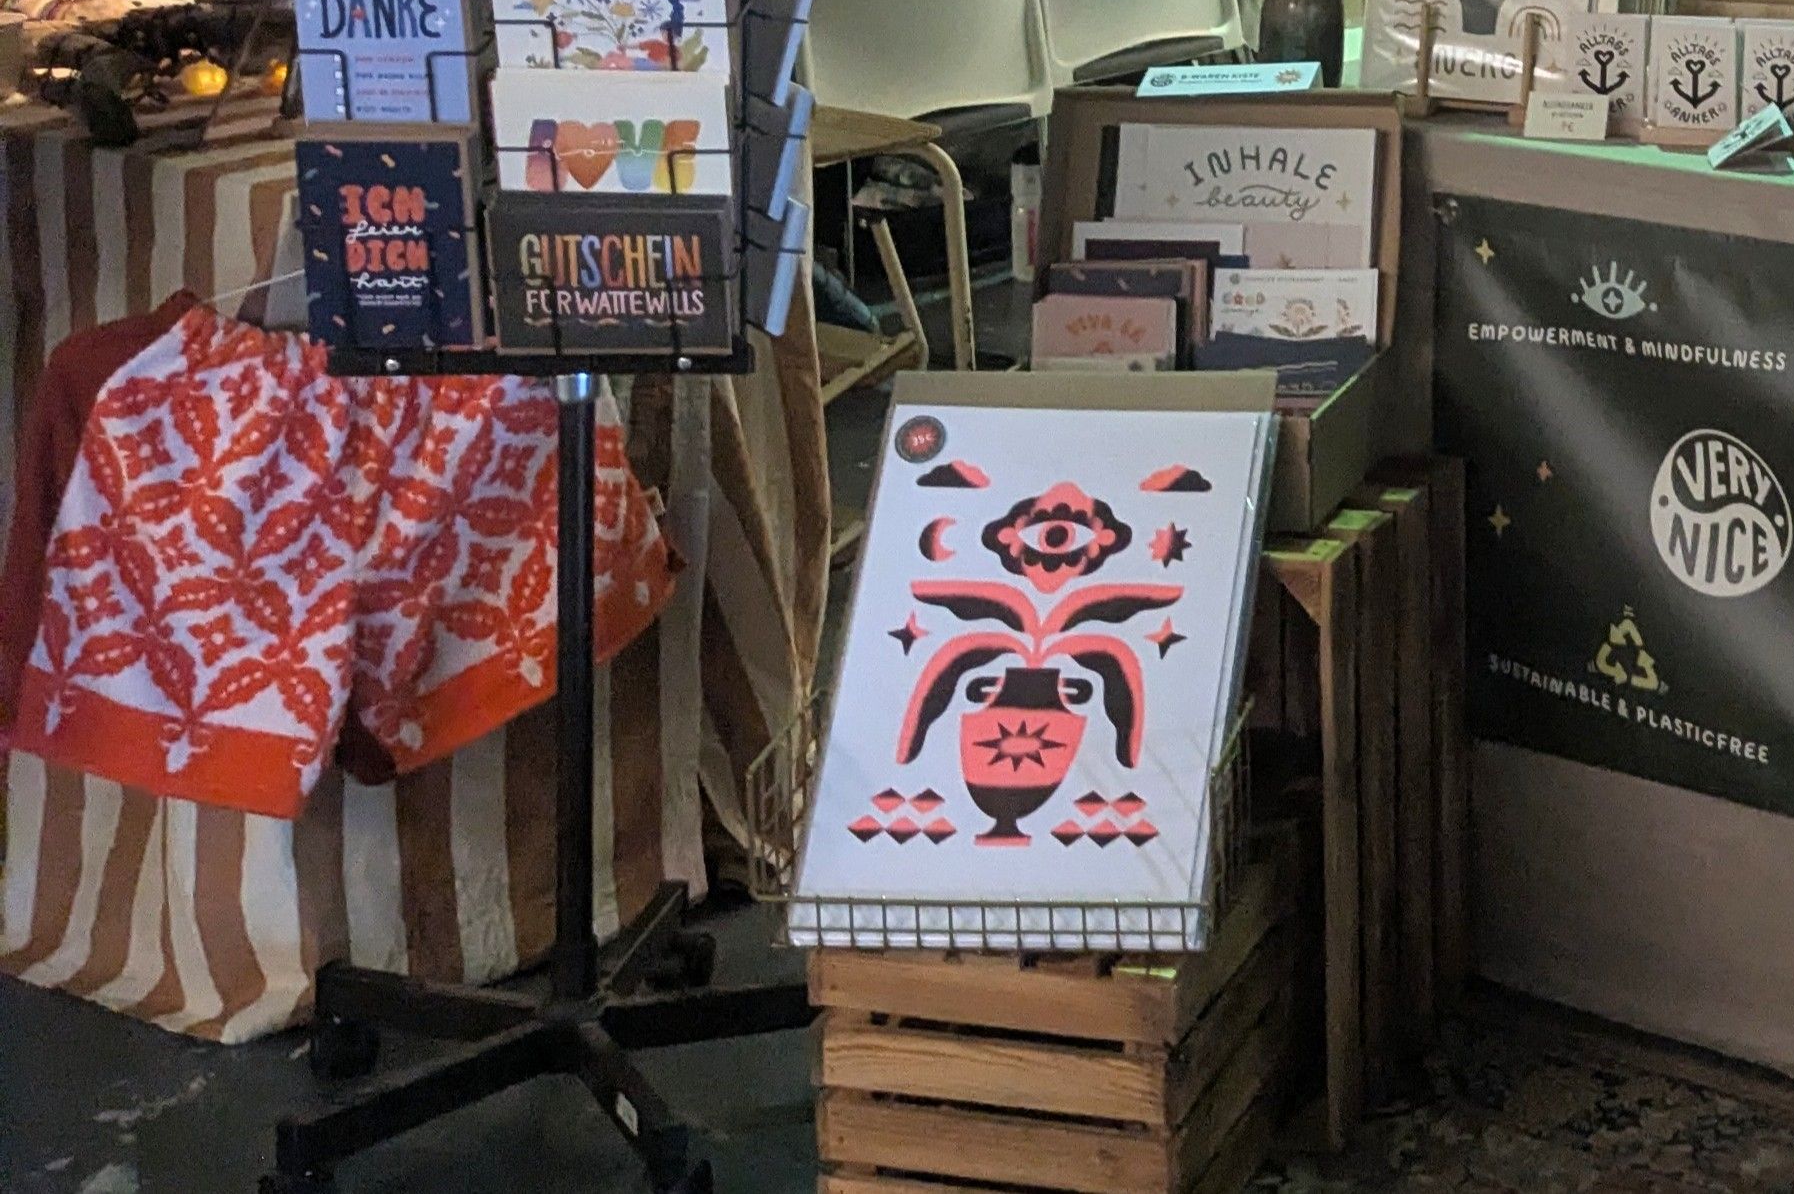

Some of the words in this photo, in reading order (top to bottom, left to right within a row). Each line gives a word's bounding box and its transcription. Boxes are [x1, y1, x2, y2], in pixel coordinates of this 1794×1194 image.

[1579, 34, 1629, 56] ALLTAGS
[1670, 43, 1722, 67] ALLTAGS
[1671, 105, 1720, 124] ANKER
[1183, 144, 1338, 191] INHALE
[339, 184, 427, 225] ICH
[1195, 184, 1321, 221] beauty
[345, 240, 430, 272] DICH
[519, 233, 702, 289] GUTSCHEIN
[1468, 323, 1618, 353] EMPOWERMENT
[1625, 337, 1636, 355] &
[1641, 340, 1788, 371] MINDFULNESS
[1676, 439, 1772, 506] VERY
[1668, 513, 1769, 585] NICE
[1488, 653, 1611, 712] SUSTAINABLE
[1636, 705, 1770, 764] PLASTICFREE
